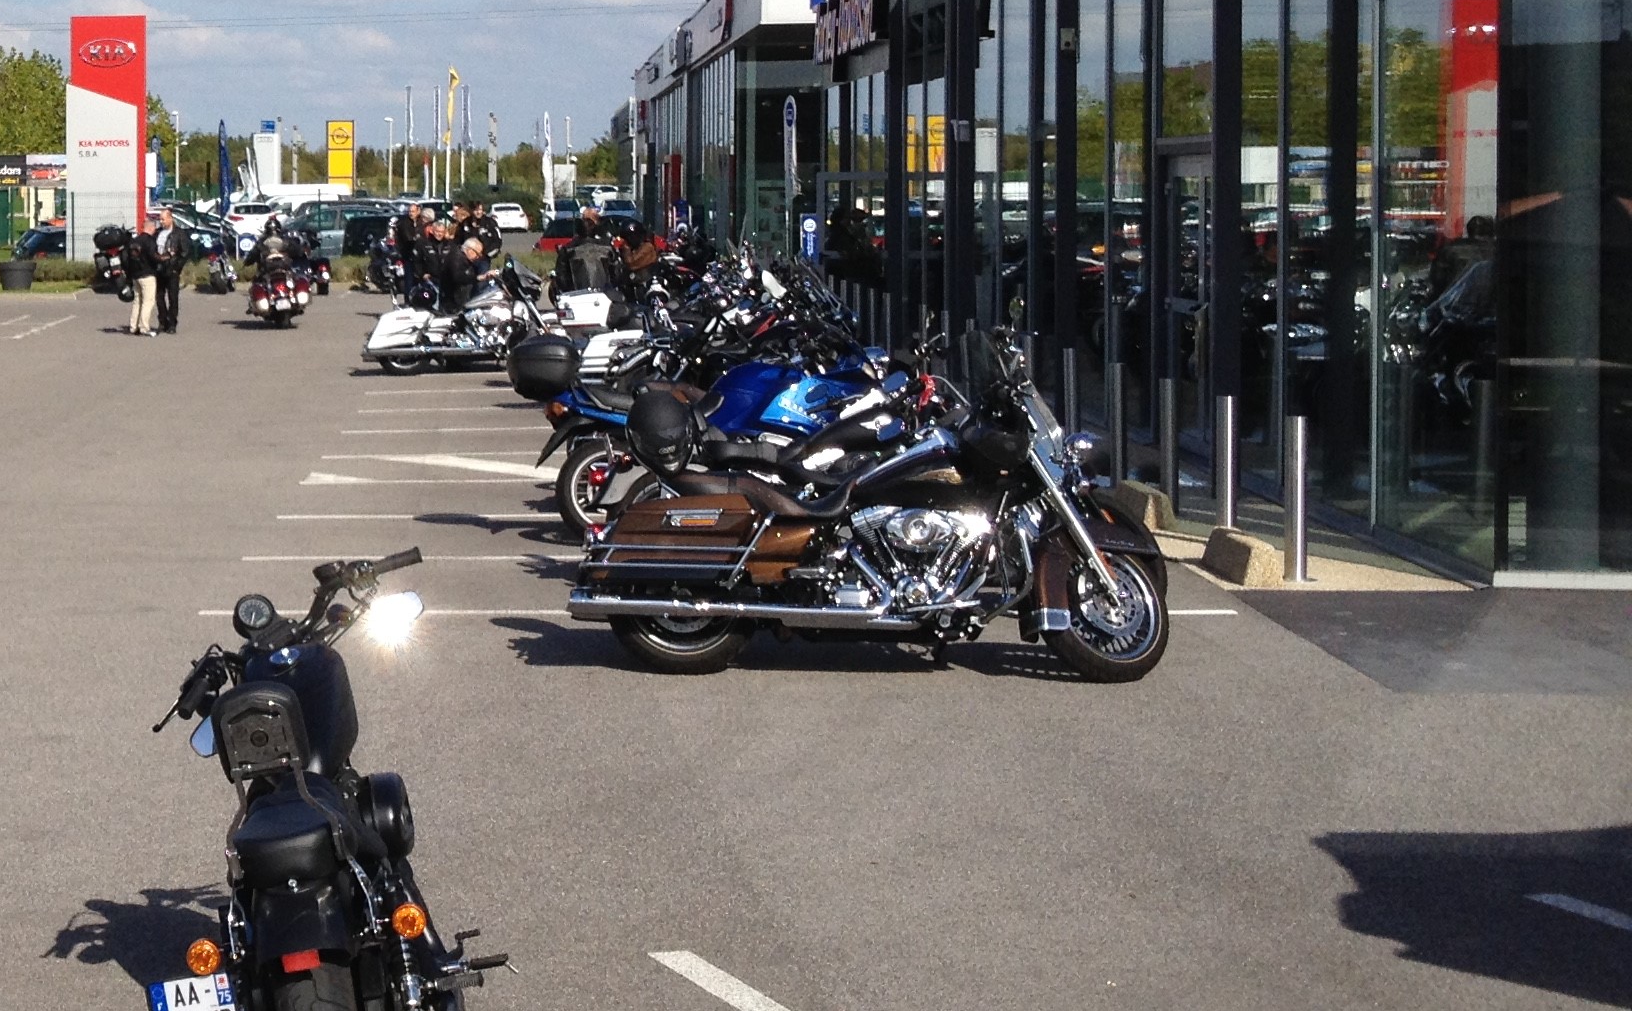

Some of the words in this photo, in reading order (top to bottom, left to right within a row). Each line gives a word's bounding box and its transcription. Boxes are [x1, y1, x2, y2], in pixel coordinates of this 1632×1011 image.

[89, 44, 127, 62] KIA
[78, 139, 93, 148] KIA
[95, 139, 130, 148] MOTORS
[218, 990, 232, 1003] 75
